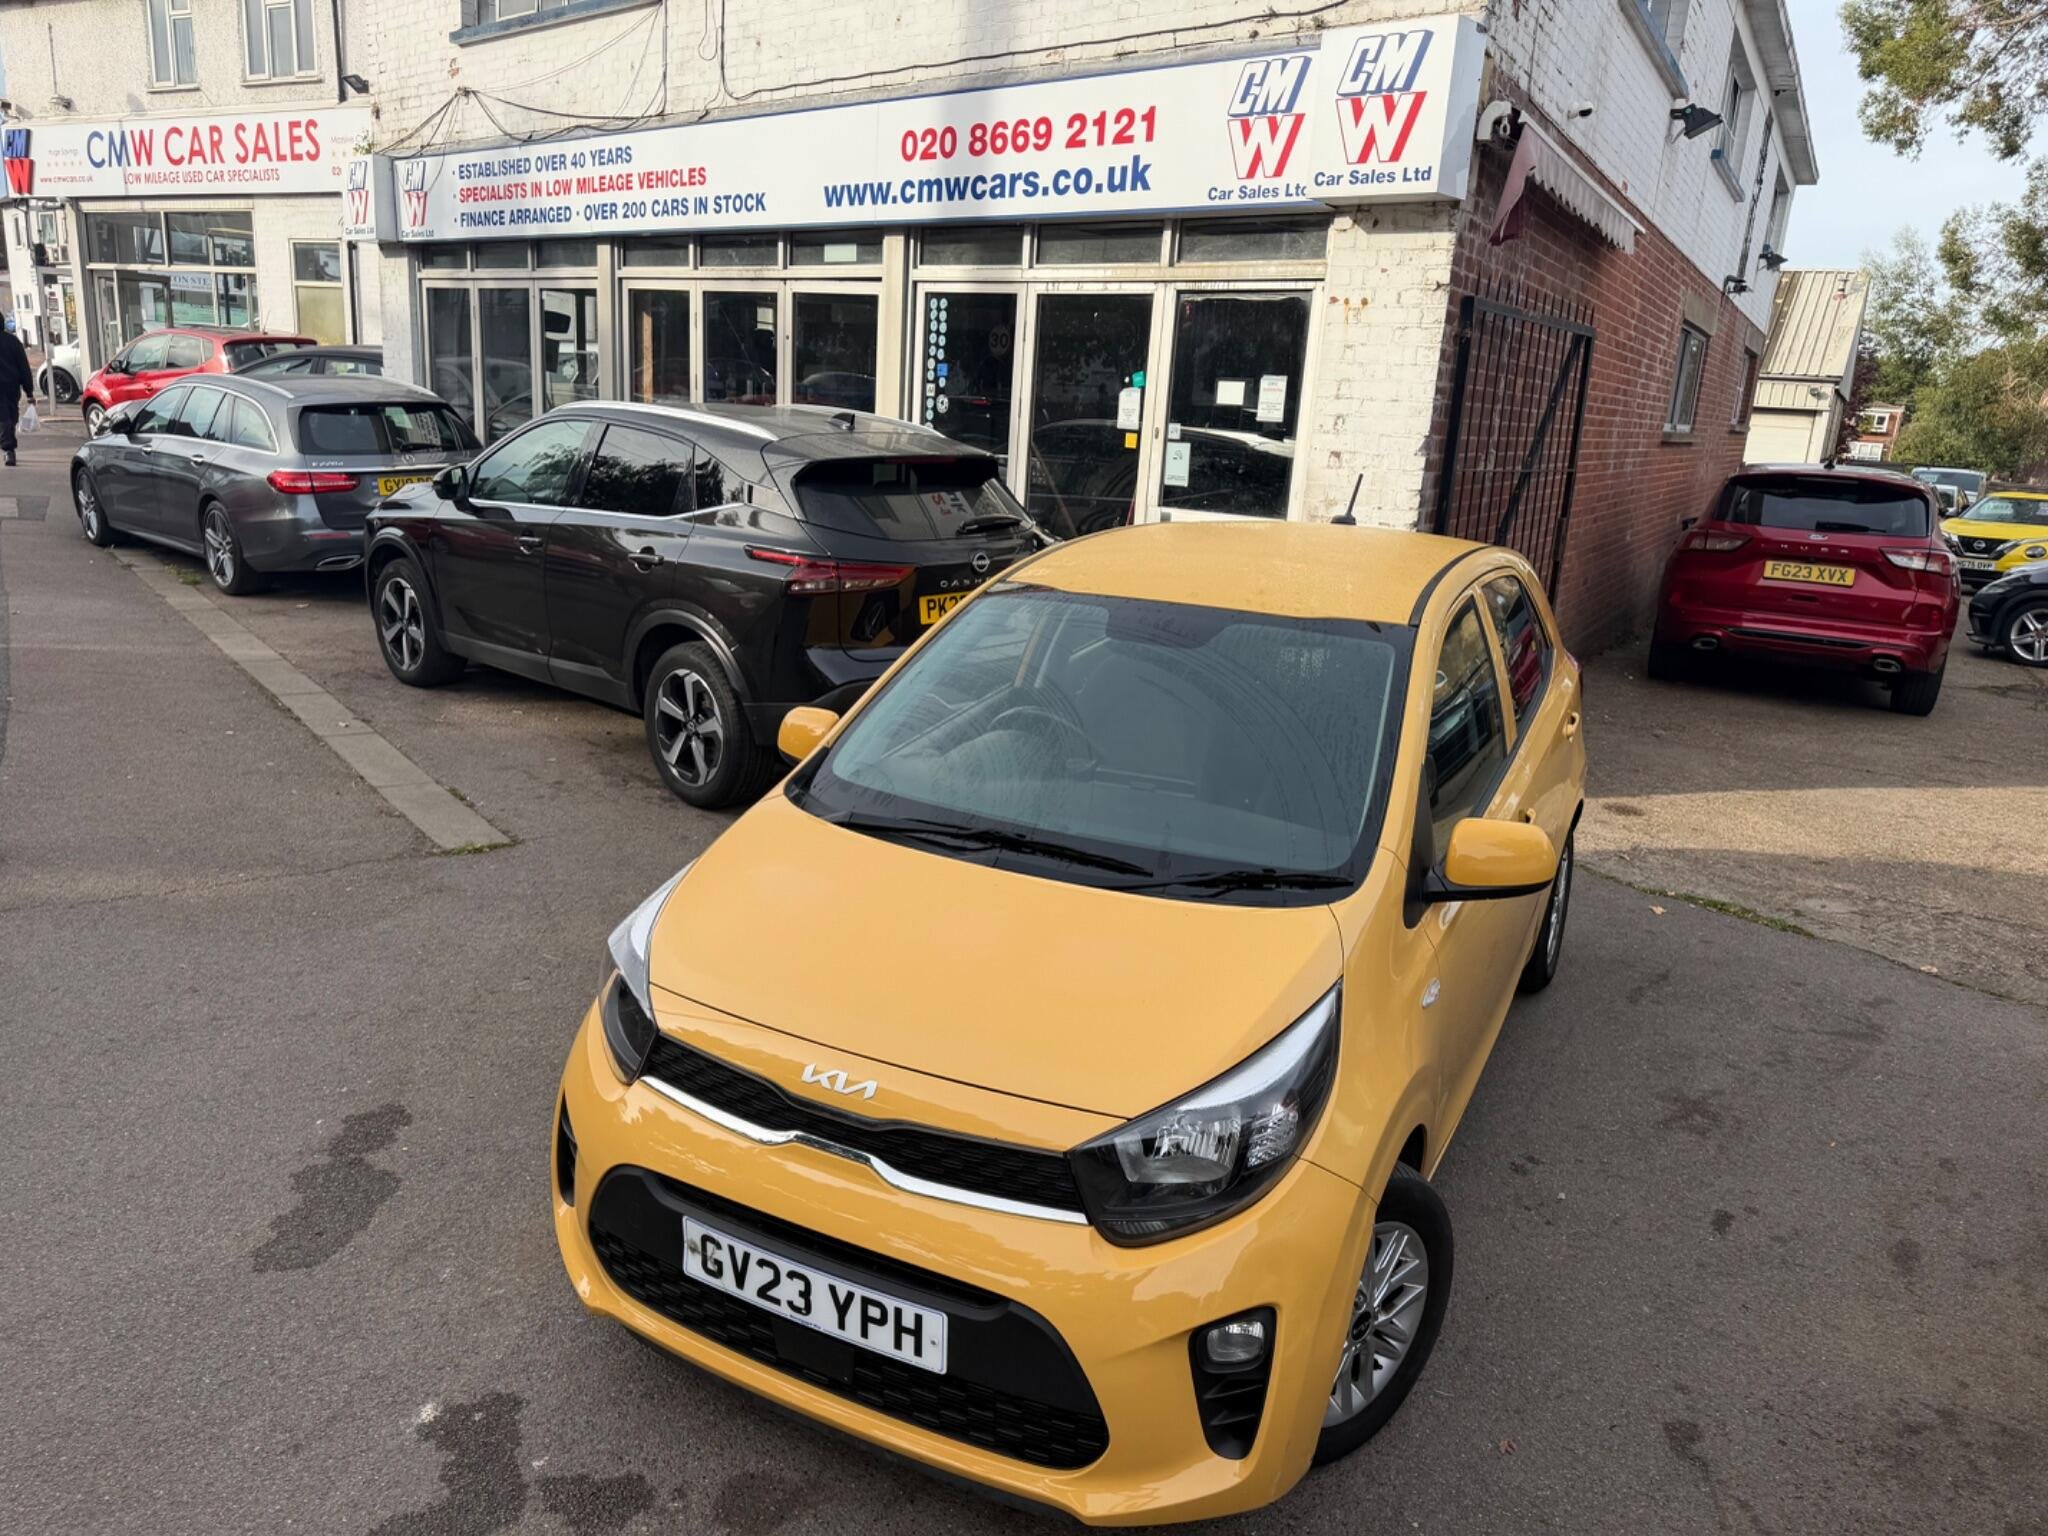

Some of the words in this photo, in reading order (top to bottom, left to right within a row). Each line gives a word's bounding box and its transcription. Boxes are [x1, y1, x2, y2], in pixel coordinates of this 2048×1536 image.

[1336, 29, 1434, 96] CM
[1227, 55, 1312, 117] CM
[86, 130, 153, 168] CMW
[164, 126, 225, 166] CAR
[234, 118, 321, 164] SALES
[901, 125, 957, 162] 020
[968, 116, 1052, 157] 8669
[1065, 105, 1157, 149] 2121
[1227, 112, 1306, 179] W
[1335, 91, 1428, 165] W
[123, 172, 142, 185] LOW
[144, 171, 181, 184] MILEAGE
[182, 170, 203, 183] USED
[205, 169, 226, 183] CAR
[227, 168, 280, 182] SPECIALISTS
[458, 157, 532, 180] ESTABLISHED
[535, 153, 567, 172] OVER
[570, 151, 586, 169] 40
[590, 145, 633, 167] YEARS
[824, 154, 1153, 207] www.cmwcars.co.uk
[1313, 171, 1344, 187] Car
[1348, 168, 1396, 185] Sales
[1401, 165, 1432, 183] Ltd
[459, 182, 528, 203] SPECIALISTS
[531, 180, 542, 198] IN
[546, 178, 573, 197] LOW
[576, 173, 633, 195] MILEAGE
[637, 166, 707, 190] VEHICLES
[1208, 187, 1234, 201] Car
[1238, 184, 1279, 199] Sales
[460, 209, 506, 228] FINANCE
[509, 205, 572, 225] ARRANGED
[584, 201, 618, 221] OVER
[622, 201, 647, 219] 200
[651, 197, 689, 217] CARS
[694, 196, 708, 214] IN
[713, 192, 767, 214] STOCK
[1770, 563, 1812, 579] FG23
[1816, 567, 1847, 583] XVX
[928, 595, 967, 618] PK2
[700, 1234, 812, 1316] GV23
[829, 1283, 923, 1358] YPH
